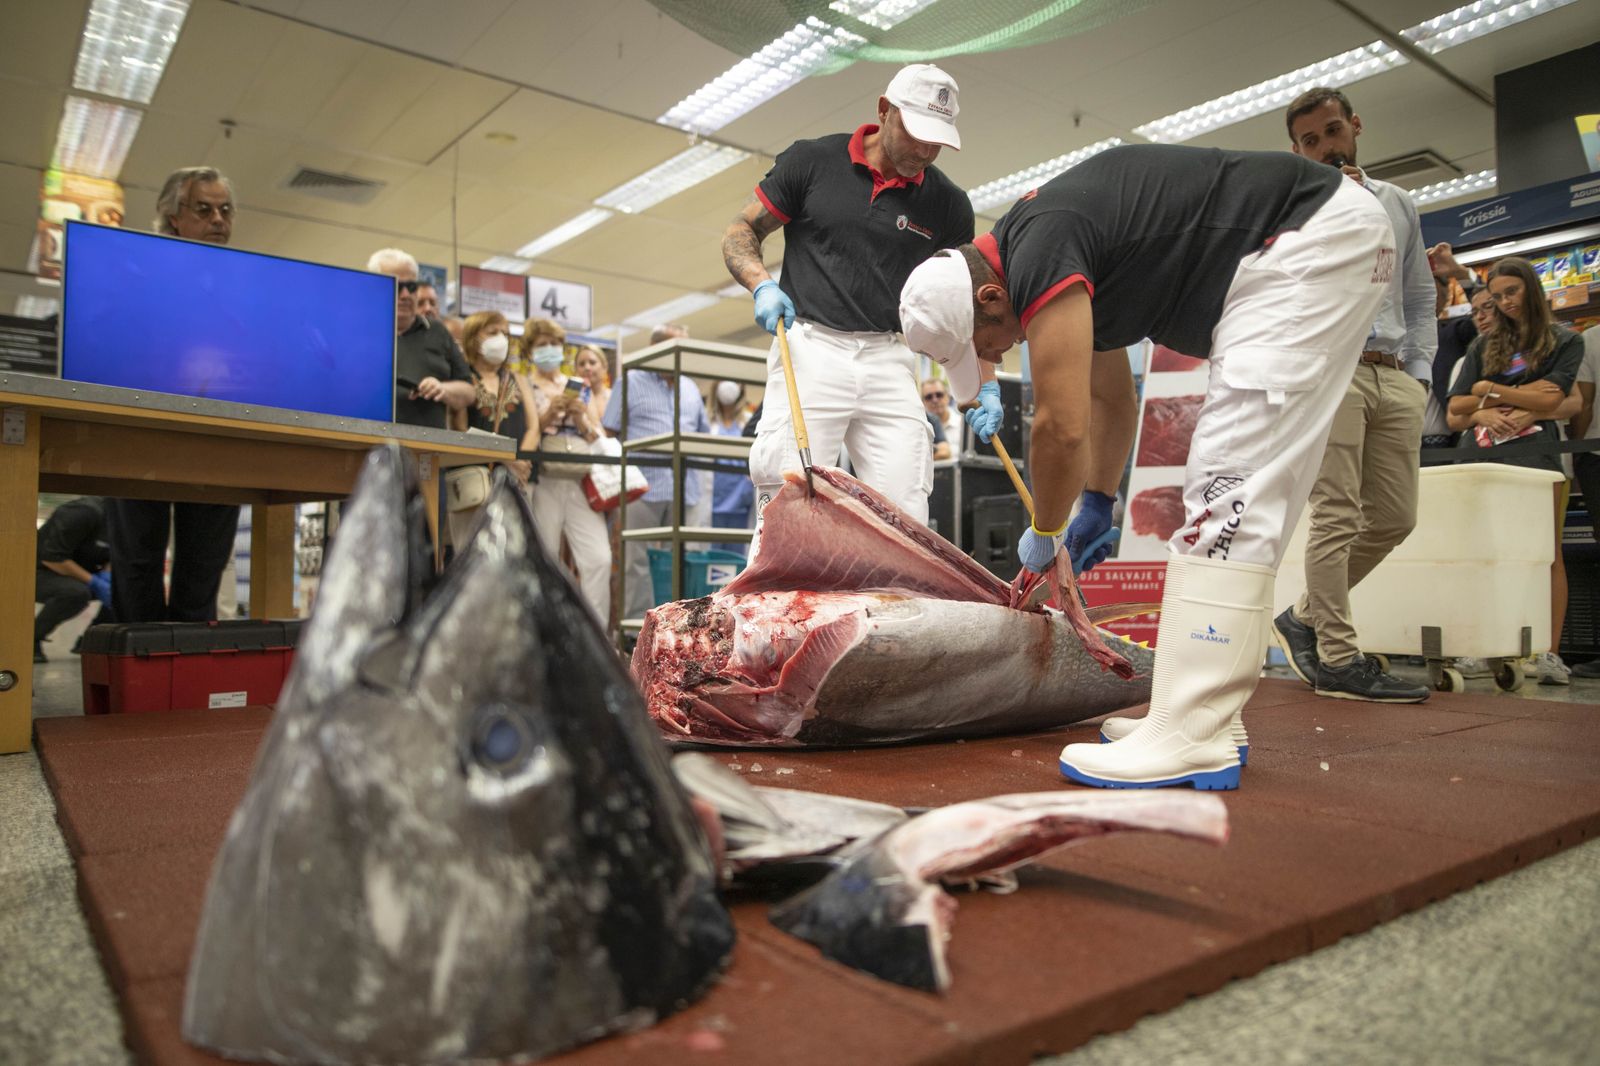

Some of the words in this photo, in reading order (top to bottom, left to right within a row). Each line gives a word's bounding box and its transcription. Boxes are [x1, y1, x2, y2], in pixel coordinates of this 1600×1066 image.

[1463, 204, 1507, 229] Krissia
[1079, 571, 1100, 581] OJO
[1105, 571, 1153, 581] SALVAJE
[1157, 571, 1165, 580] D
[1190, 632, 1231, 645] DIKAMAR
